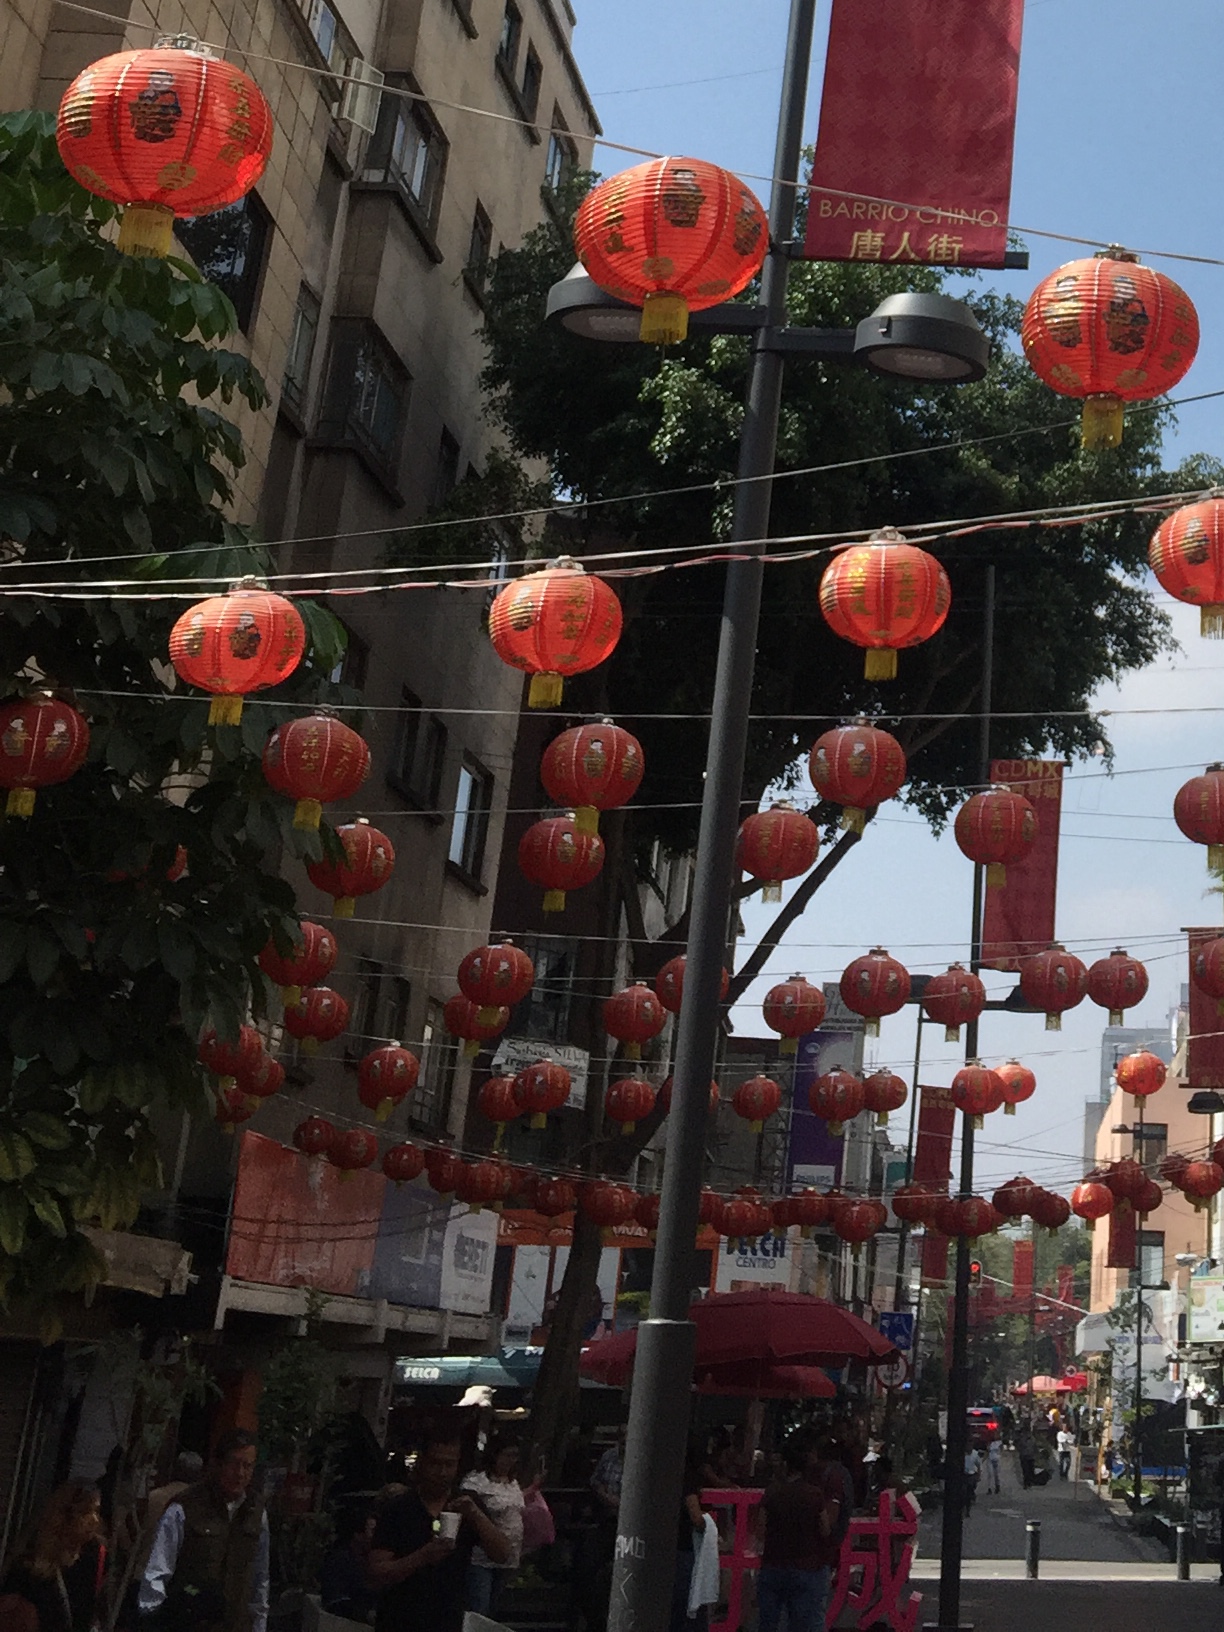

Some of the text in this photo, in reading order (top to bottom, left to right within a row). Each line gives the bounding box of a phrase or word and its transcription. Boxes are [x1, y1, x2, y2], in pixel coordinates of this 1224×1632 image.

[819, 199, 999, 227] BARRIO CHINO
[850, 228, 964, 264] 唐人街
[995, 759, 1060, 780] CDMX
[735, 1256, 776, 1269] CENTRO
